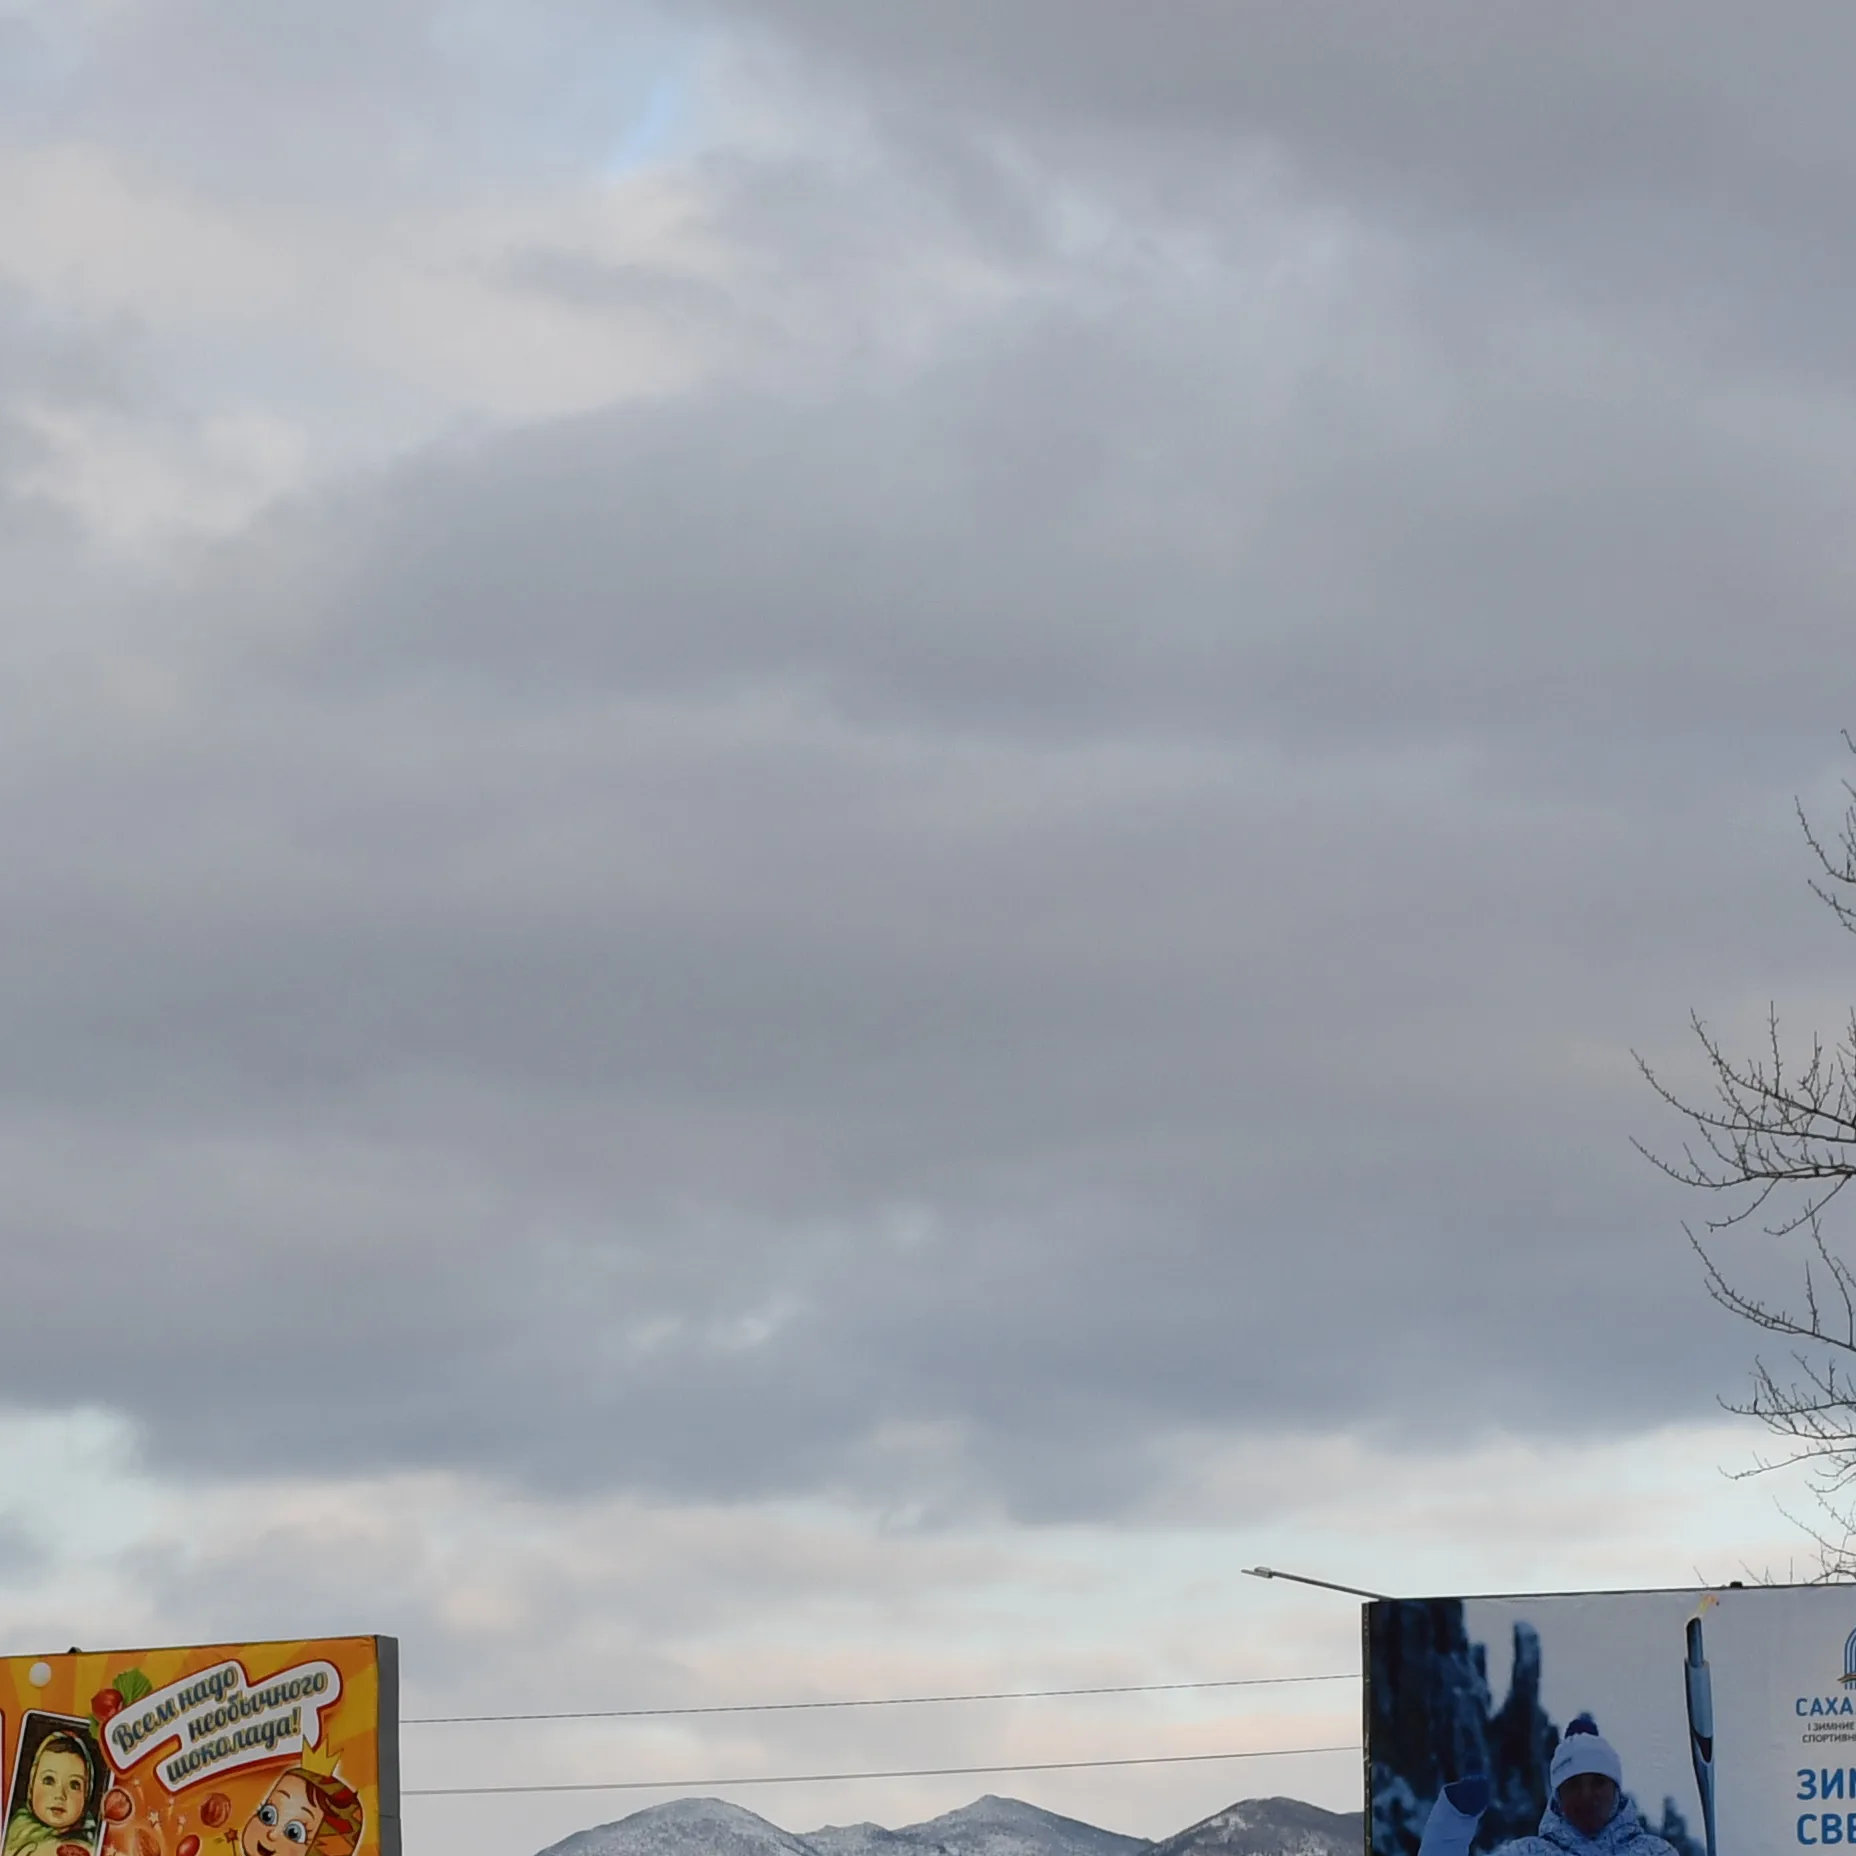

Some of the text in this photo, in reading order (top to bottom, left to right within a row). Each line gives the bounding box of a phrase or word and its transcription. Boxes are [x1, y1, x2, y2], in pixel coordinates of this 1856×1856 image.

[111, 1666, 238, 1753] Всем надо
[188, 1671, 328, 1742] необычного
[1813, 1722, 1854, 1731] ЗИМНИЕ
[166, 1707, 302, 1782] шоколада!
